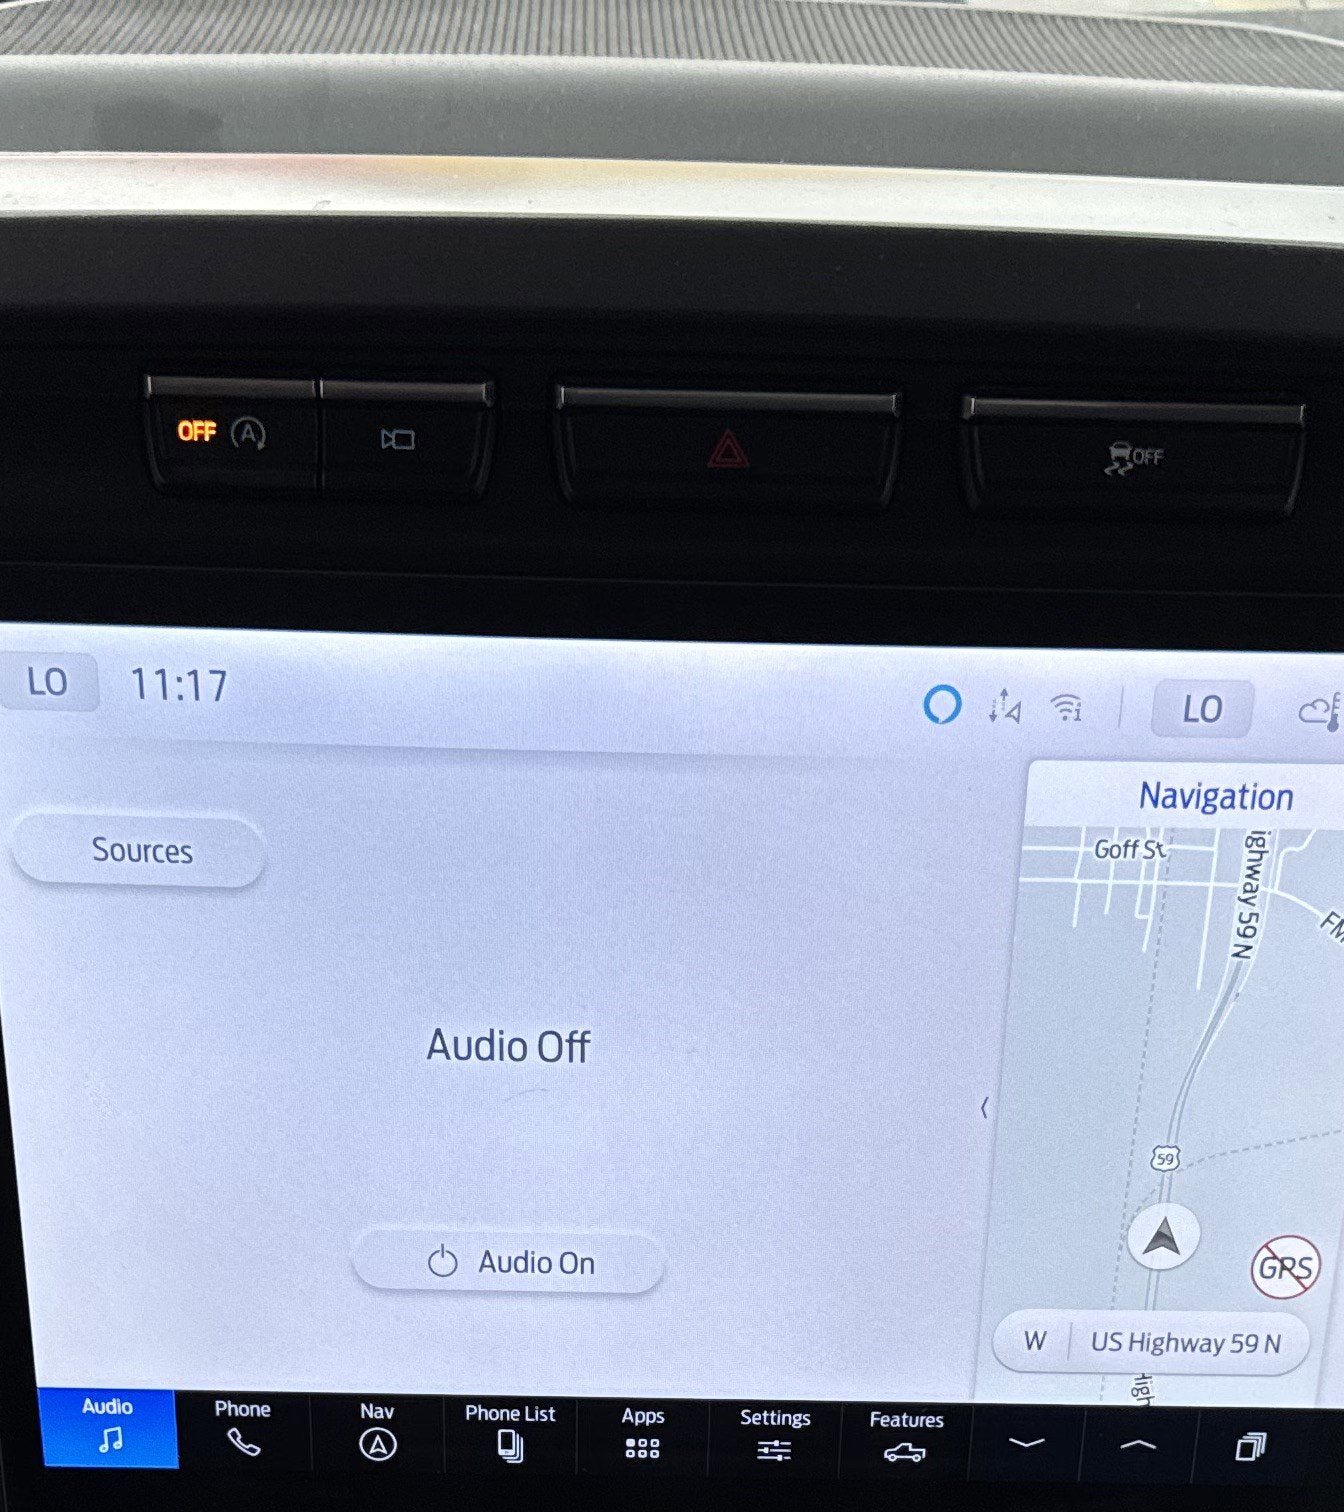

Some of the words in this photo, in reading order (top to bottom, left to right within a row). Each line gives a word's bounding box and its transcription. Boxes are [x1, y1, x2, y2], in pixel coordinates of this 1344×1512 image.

[177, 420, 217, 442] OFF
[1133, 448, 1164, 466] OFF
[27, 666, 68, 696] LO
[131, 667, 227, 702] 11:17
[1182, 694, 1223, 724] LO
[1139, 780, 1294, 815] Navigation
[92, 836, 194, 864] Sources
[1094, 838, 1139, 860] Goff
[1143, 838, 1167, 860] St
[1236, 911, 1260, 939] 59
[1230, 943, 1254, 960] N
[426, 1027, 529, 1063] Audio
[537, 1029, 593, 1064] Off
[1156, 1152, 1174, 1166] 59
[478, 1249, 553, 1275] Audio
[558, 1250, 595, 1275] On
[1024, 1330, 1048, 1351] W
[1091, 1331, 1123, 1352] US
[1128, 1332, 1226, 1357] Highway
[1229, 1333, 1259, 1354] 59
[1264, 1334, 1282, 1354] N
[82, 1396, 134, 1415] Audio
[215, 1399, 272, 1418] Phone
[361, 1402, 395, 1420] Nav
[465, 1404, 520, 1421] Phone
[524, 1405, 557, 1422] List
[621, 1407, 666, 1427] Apps
[740, 1409, 812, 1429] Settings
[870, 1411, 945, 1429] Features
